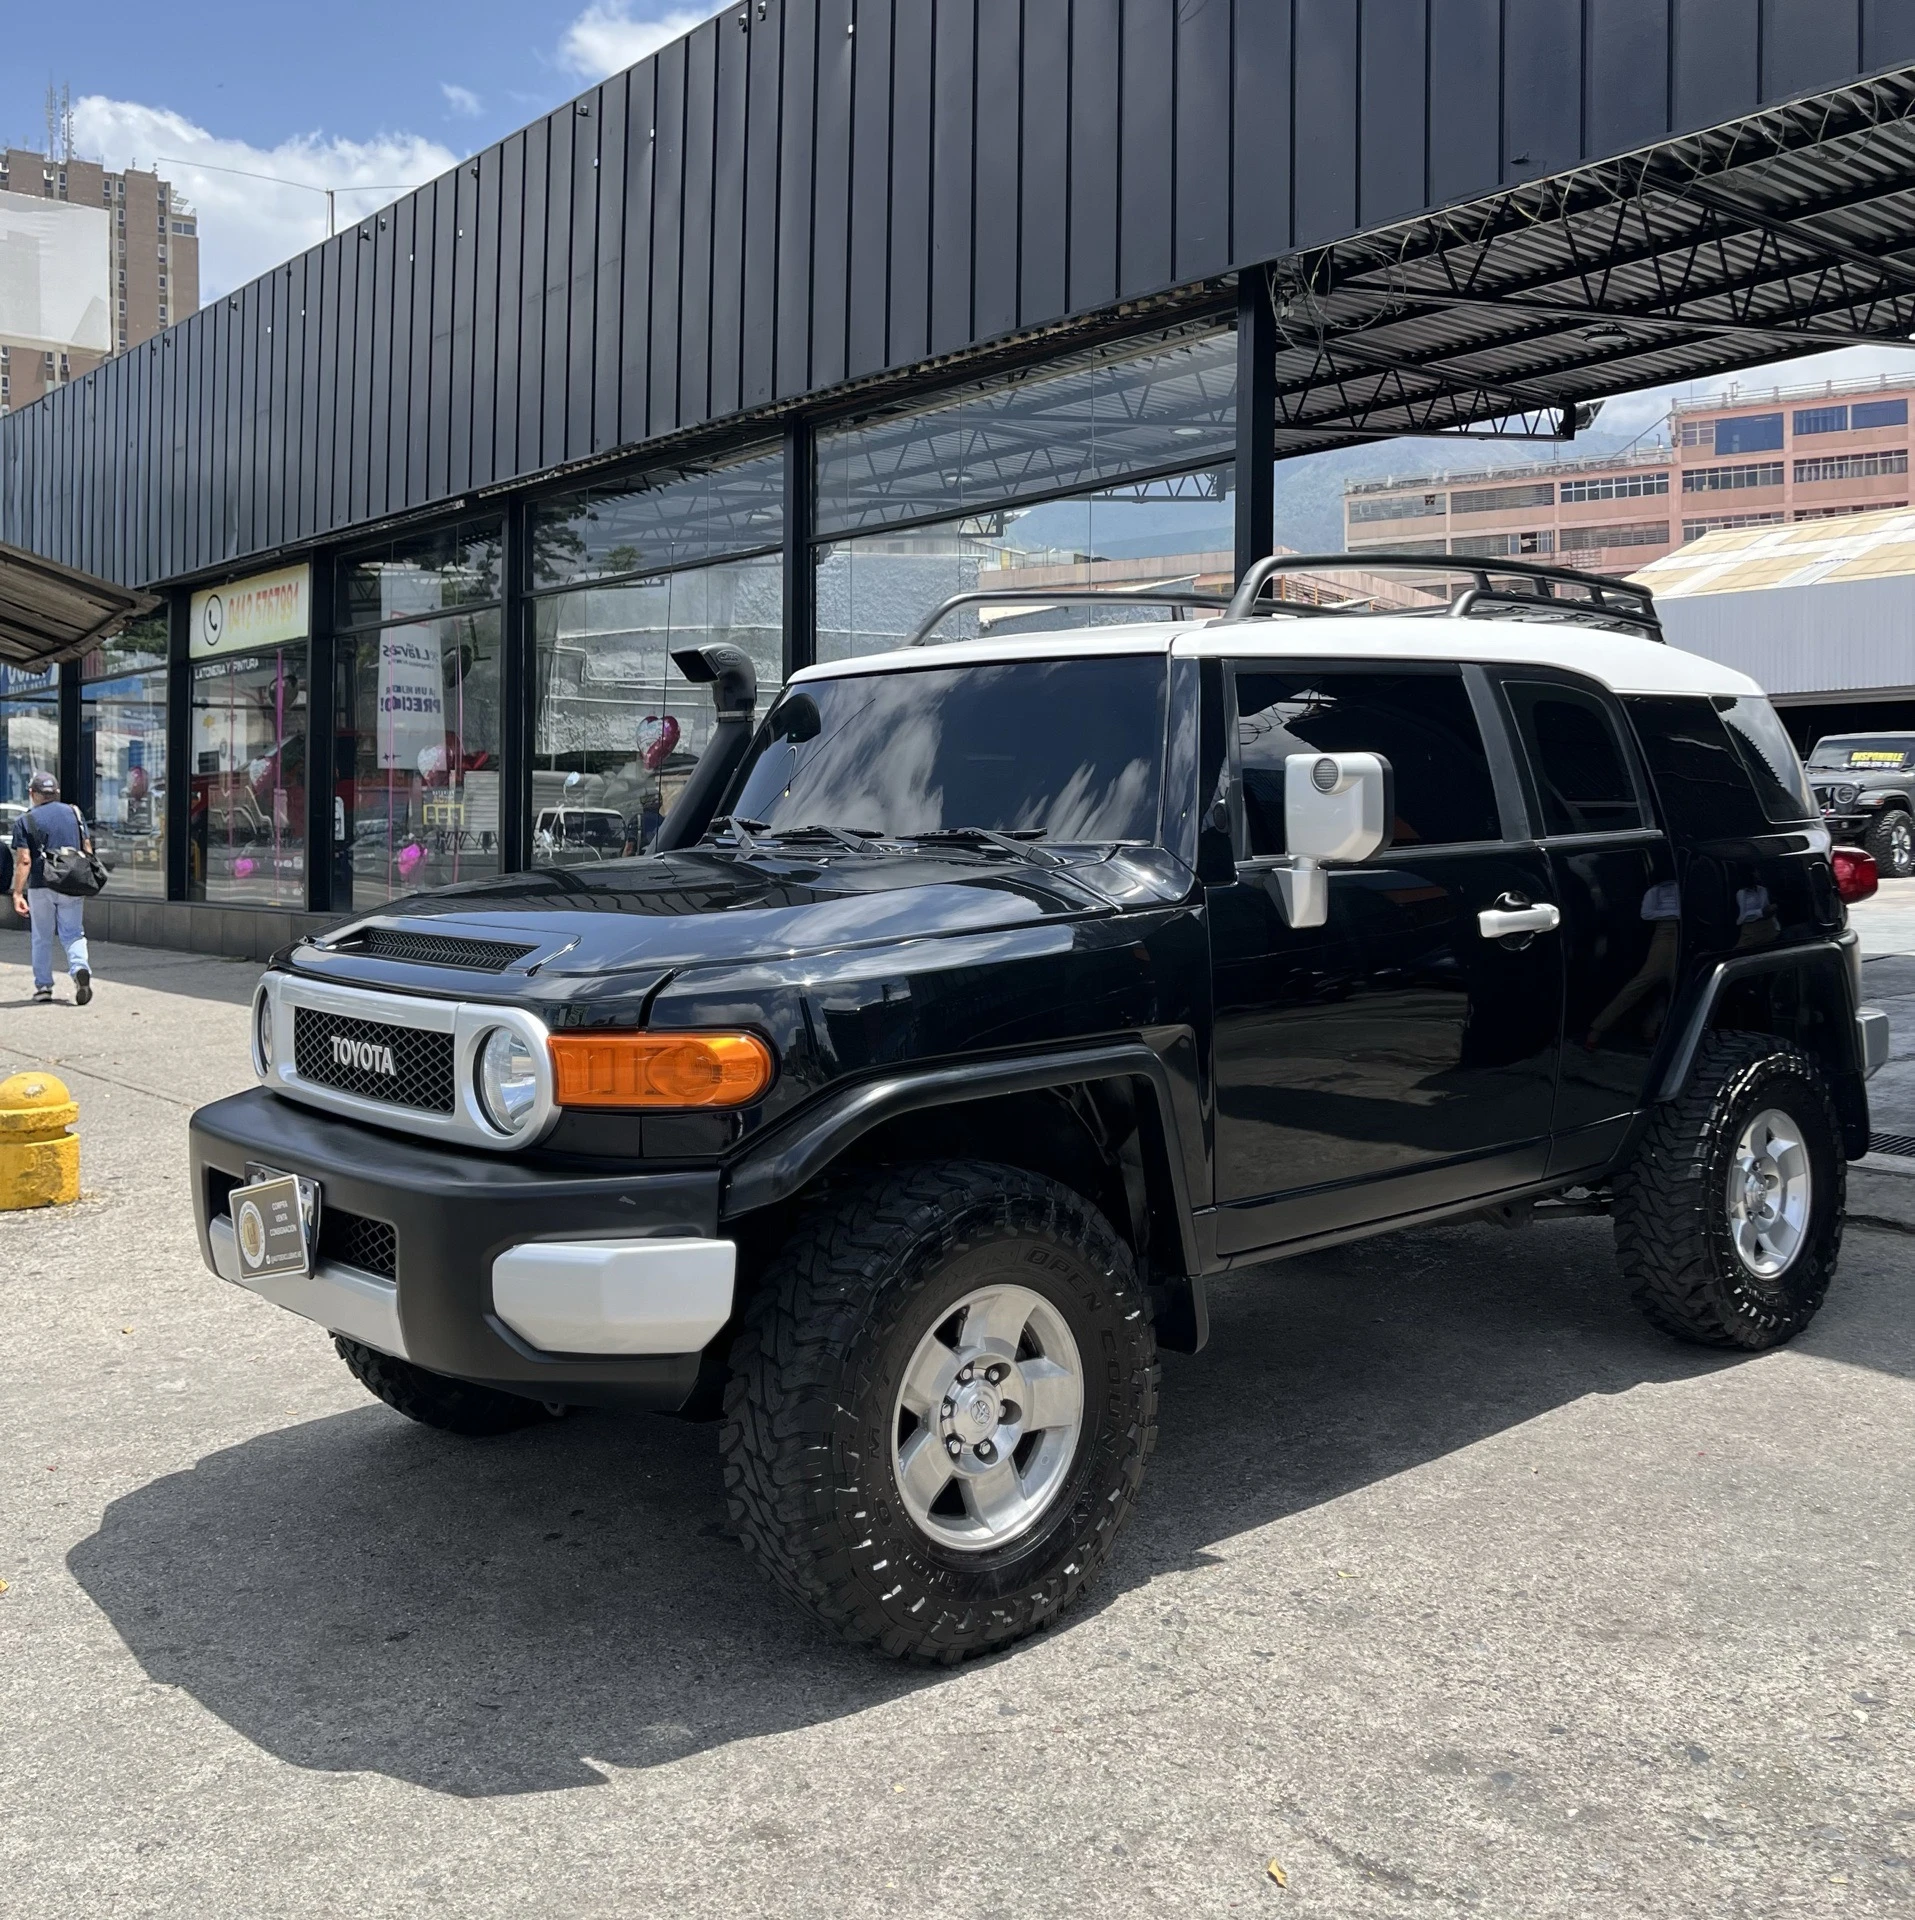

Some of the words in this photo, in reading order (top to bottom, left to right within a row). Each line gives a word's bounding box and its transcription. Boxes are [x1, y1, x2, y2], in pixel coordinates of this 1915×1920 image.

[228, 592, 252, 633] 0412
[233, 658, 259, 672] PINTURA
[1851, 752, 1905, 762] DISPONIBLE
[331, 1035, 397, 1077] TOYOTA
[1024, 1247, 1102, 1312] OPEN
